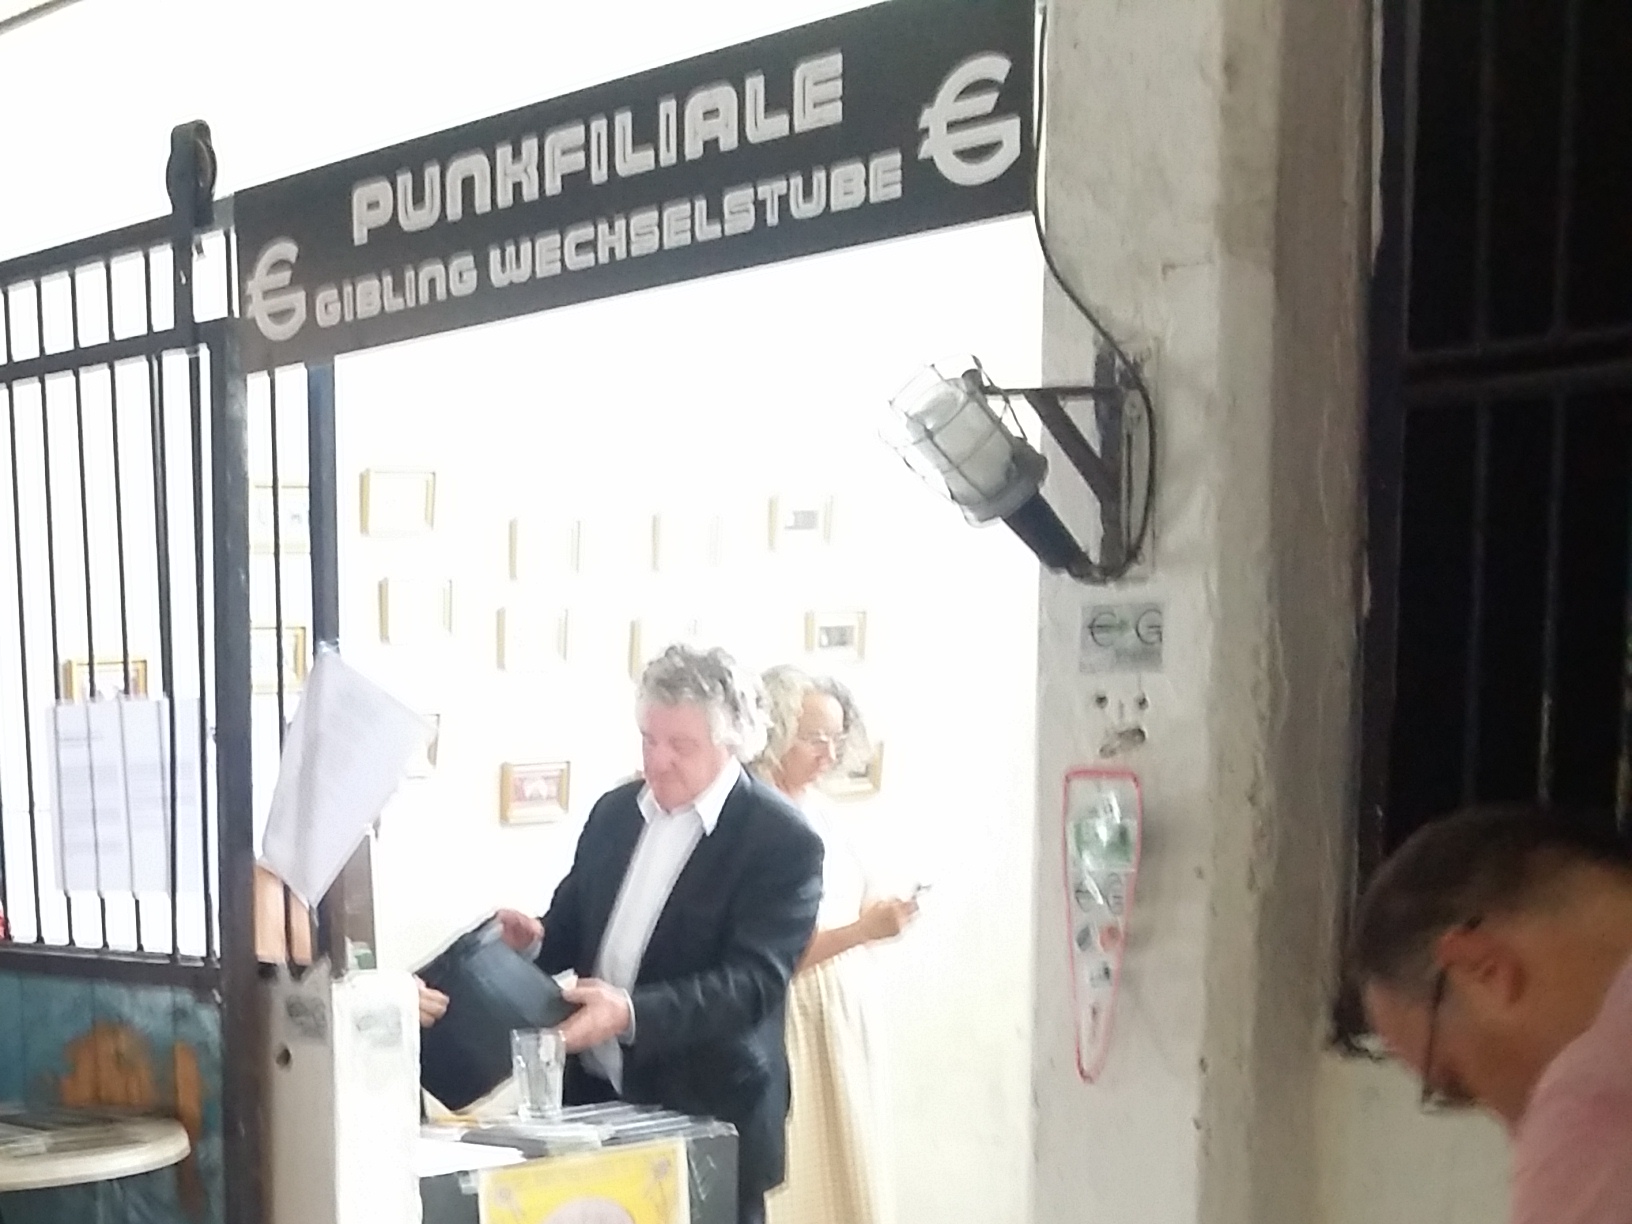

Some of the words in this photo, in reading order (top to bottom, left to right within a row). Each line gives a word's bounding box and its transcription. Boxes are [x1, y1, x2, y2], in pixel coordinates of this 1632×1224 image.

[315, 252, 478, 328] GIBLING
[488, 151, 903, 288] WECHSELSTUBE
[351, 50, 844, 245] PUNKFILIALE
